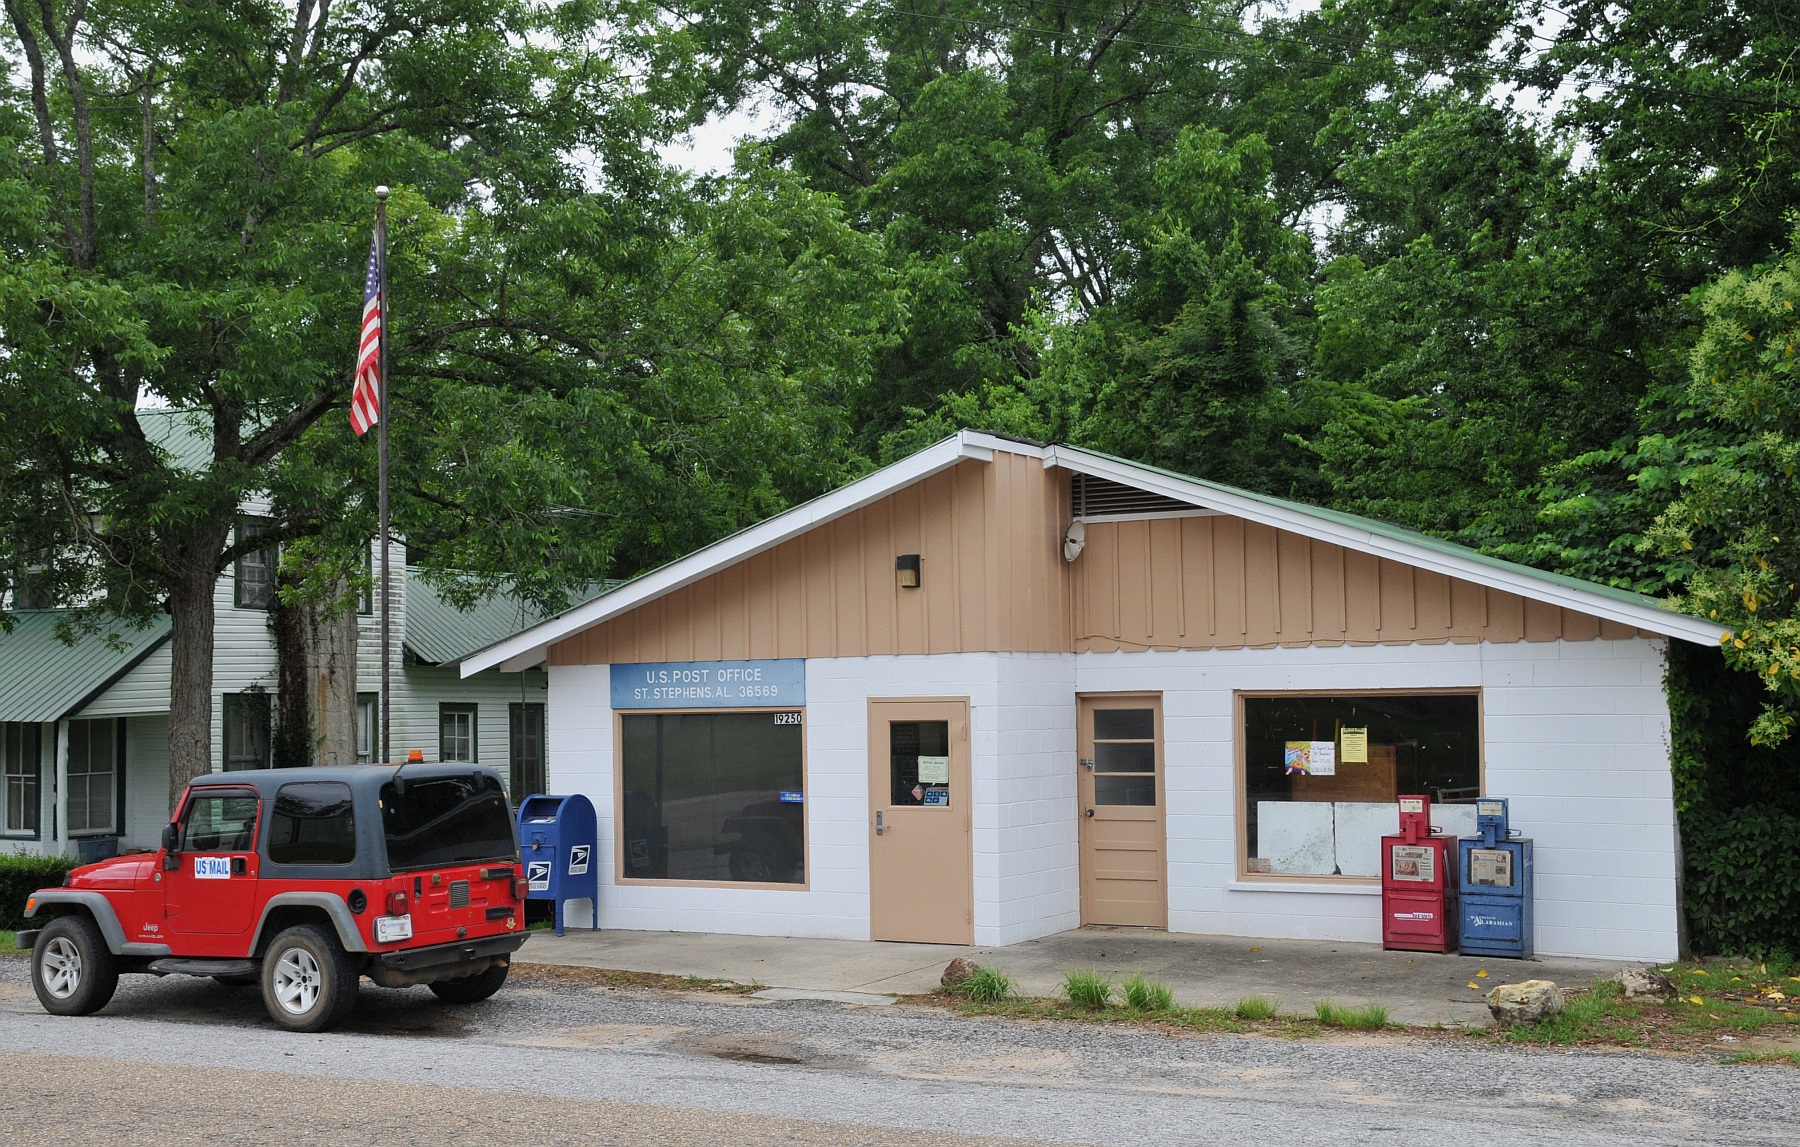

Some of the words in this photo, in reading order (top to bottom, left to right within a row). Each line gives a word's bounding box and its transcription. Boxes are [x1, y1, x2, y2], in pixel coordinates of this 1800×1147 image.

[717, 668, 762, 683] OFFICE
[634, 687, 650, 700] ST.
[739, 684, 778, 698] 36569
[774, 713, 802, 724] 19250
[196, 860, 207, 875] US
[209, 860, 229, 875] MAIL
[1412, 912, 1432, 920] NEWS
[142, 921, 159, 933] Jeep
